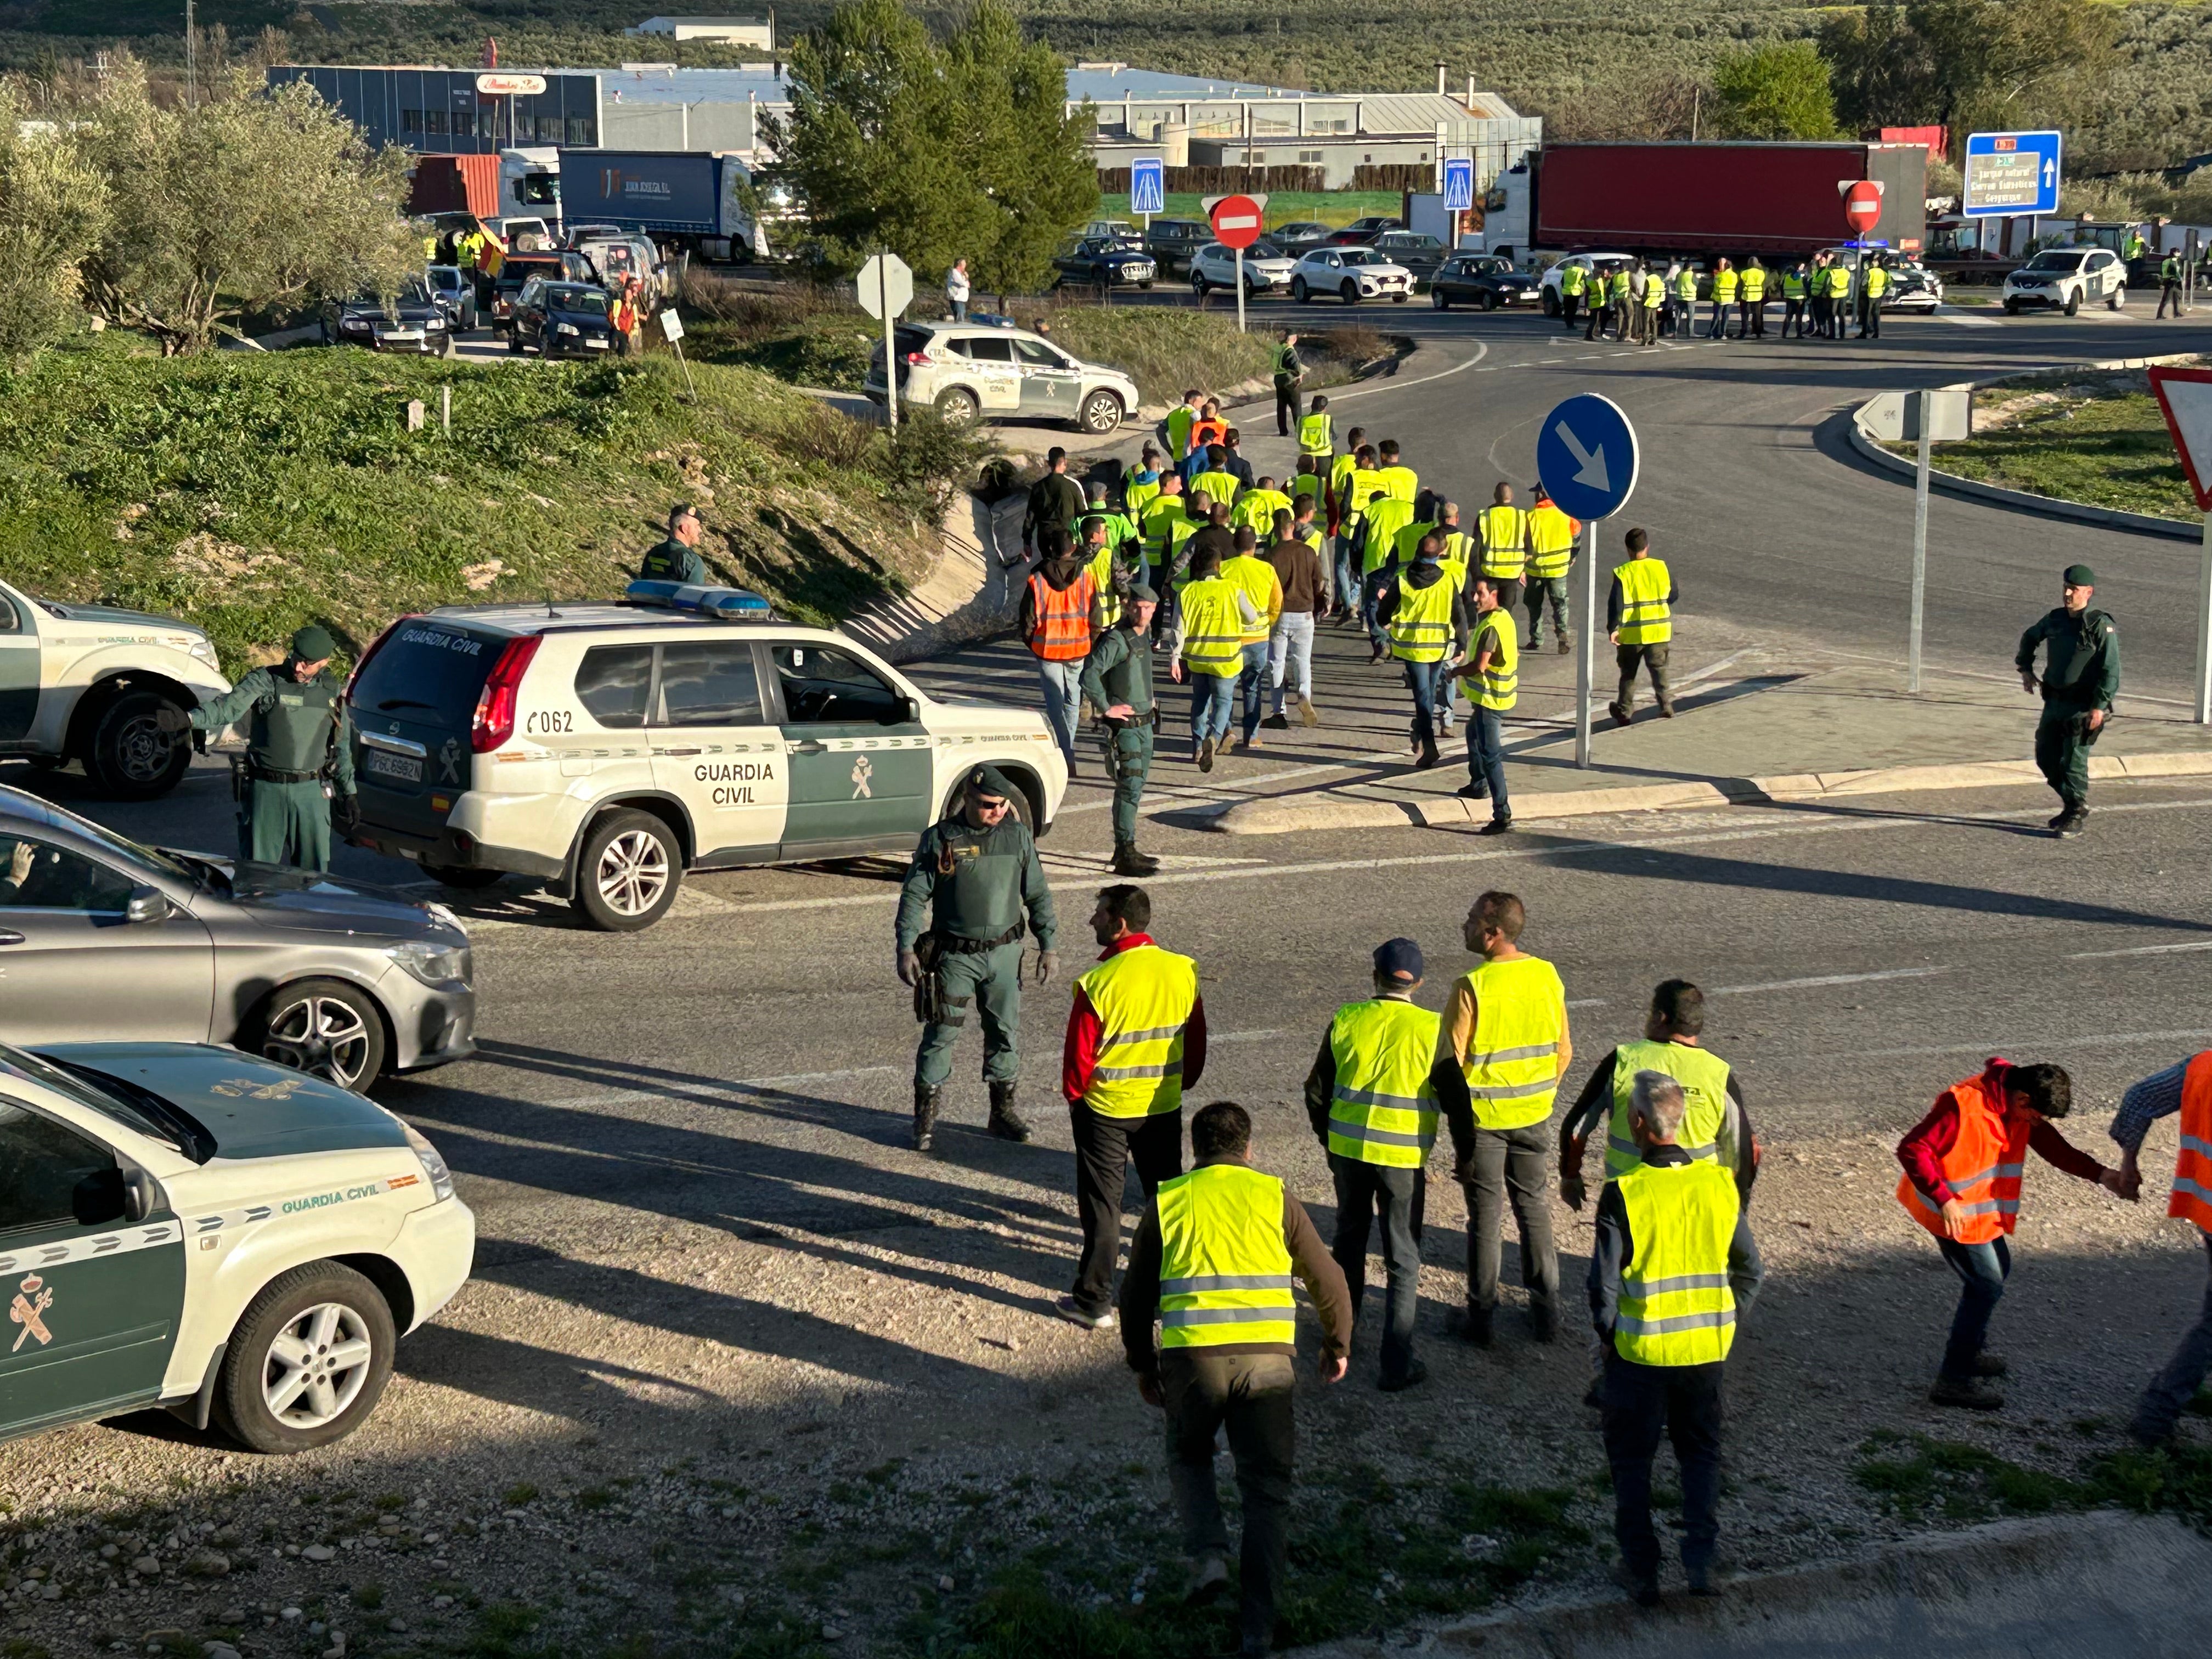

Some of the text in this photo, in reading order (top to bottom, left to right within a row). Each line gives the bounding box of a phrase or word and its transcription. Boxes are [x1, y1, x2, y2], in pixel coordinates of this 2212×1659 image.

[402, 629, 482, 656] GUARDIA CIVIL
[541, 710, 573, 732] 062
[695, 764, 774, 781] GUARDIA
[713, 787, 754, 804] CIVIL
[282, 1184, 380, 1214] GUARDIA CIVIL
